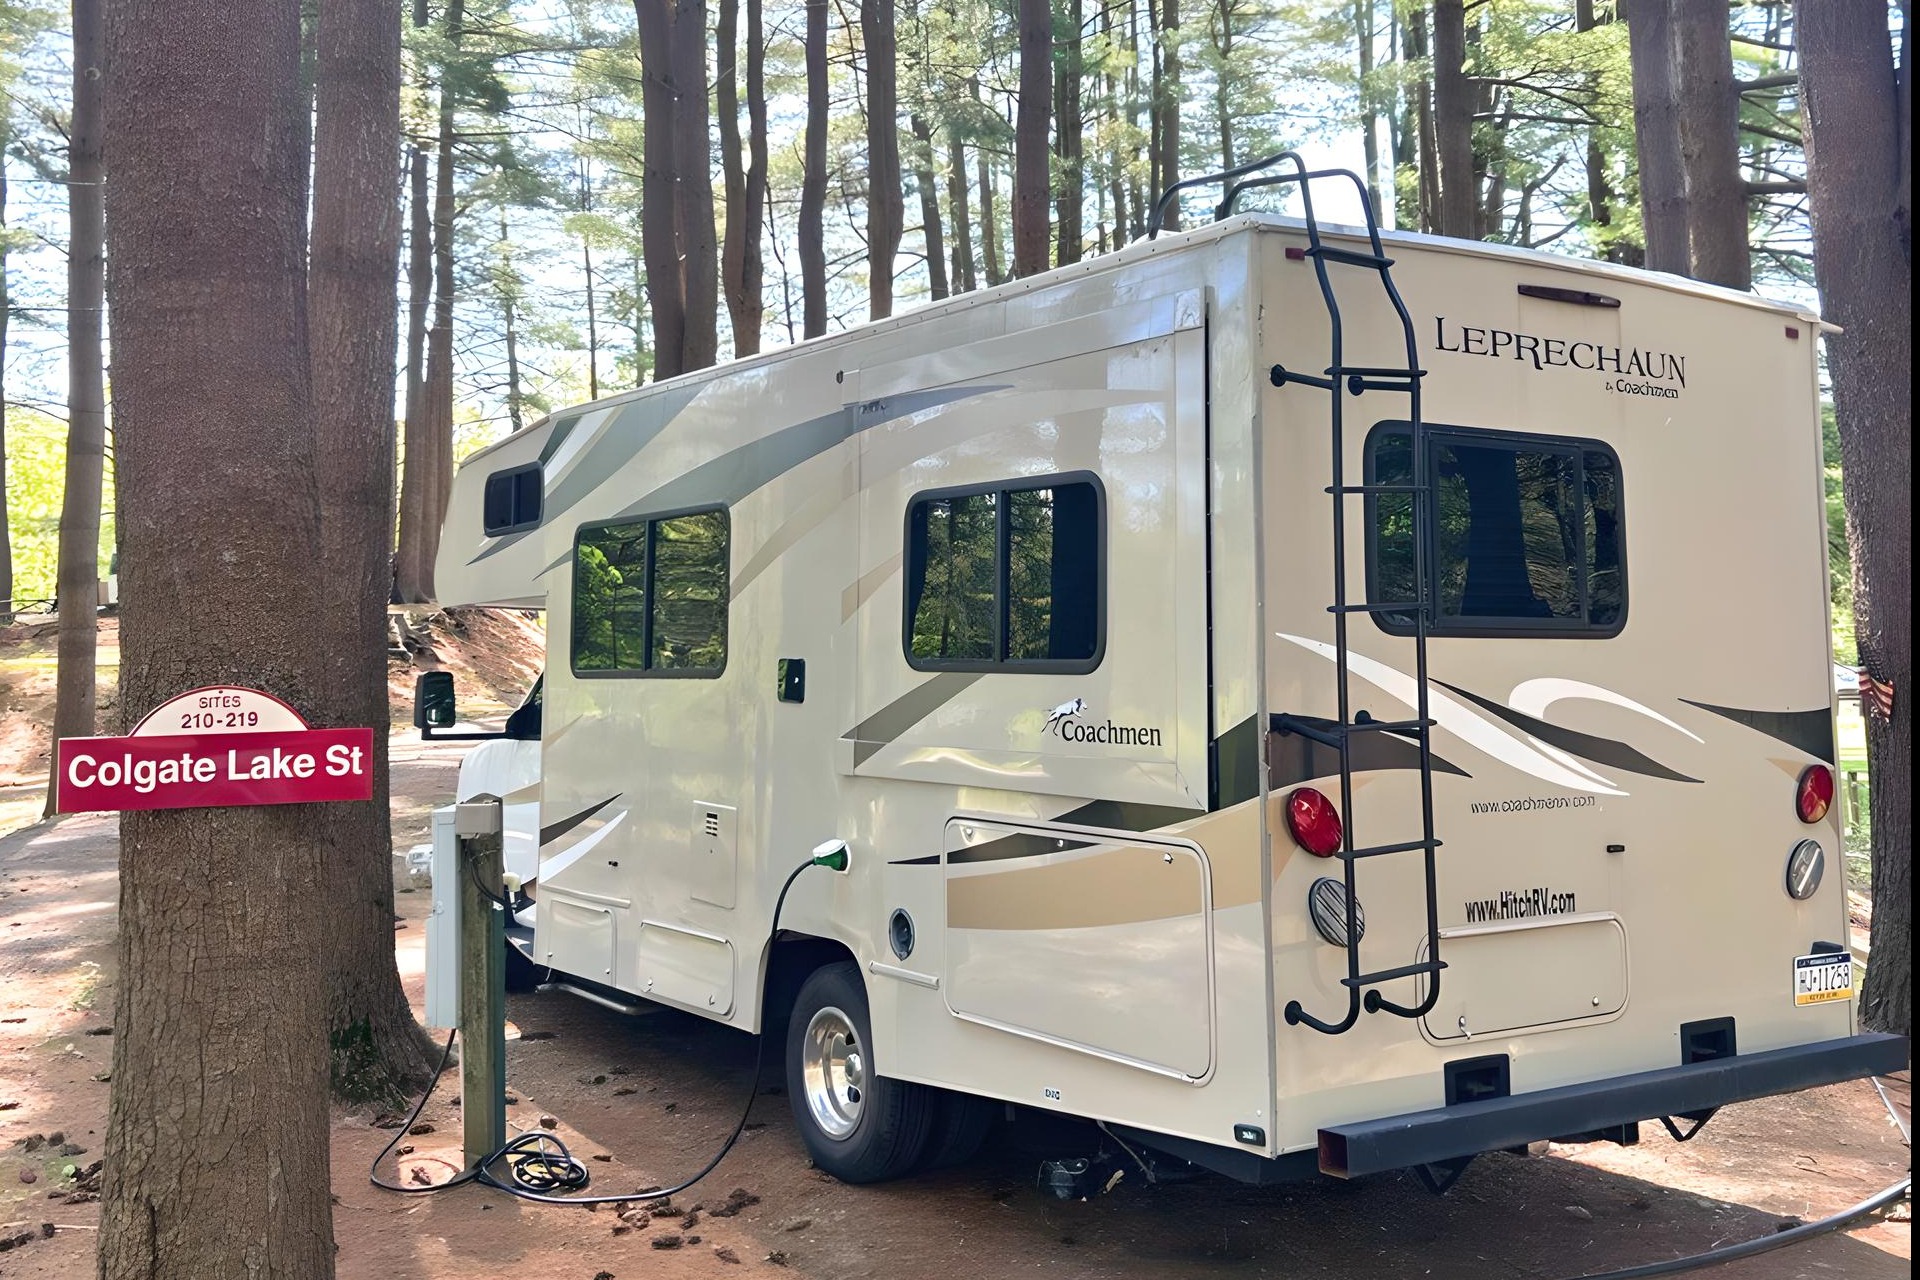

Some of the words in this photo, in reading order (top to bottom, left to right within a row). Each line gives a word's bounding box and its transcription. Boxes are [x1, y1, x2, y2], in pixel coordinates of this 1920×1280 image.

[1435, 316, 1686, 389] LEPRECHAUN
[1616, 378, 1679, 399] Coachmen
[199, 695, 241, 709] SITES
[181, 711, 258, 729] 210-219
[1061, 719, 1162, 746] Coachmen
[68, 752, 216, 793] Colgate
[228, 746, 315, 781] Lake
[325, 744, 364, 776] St
[1465, 887, 1576, 923] www.HitchRV.com
